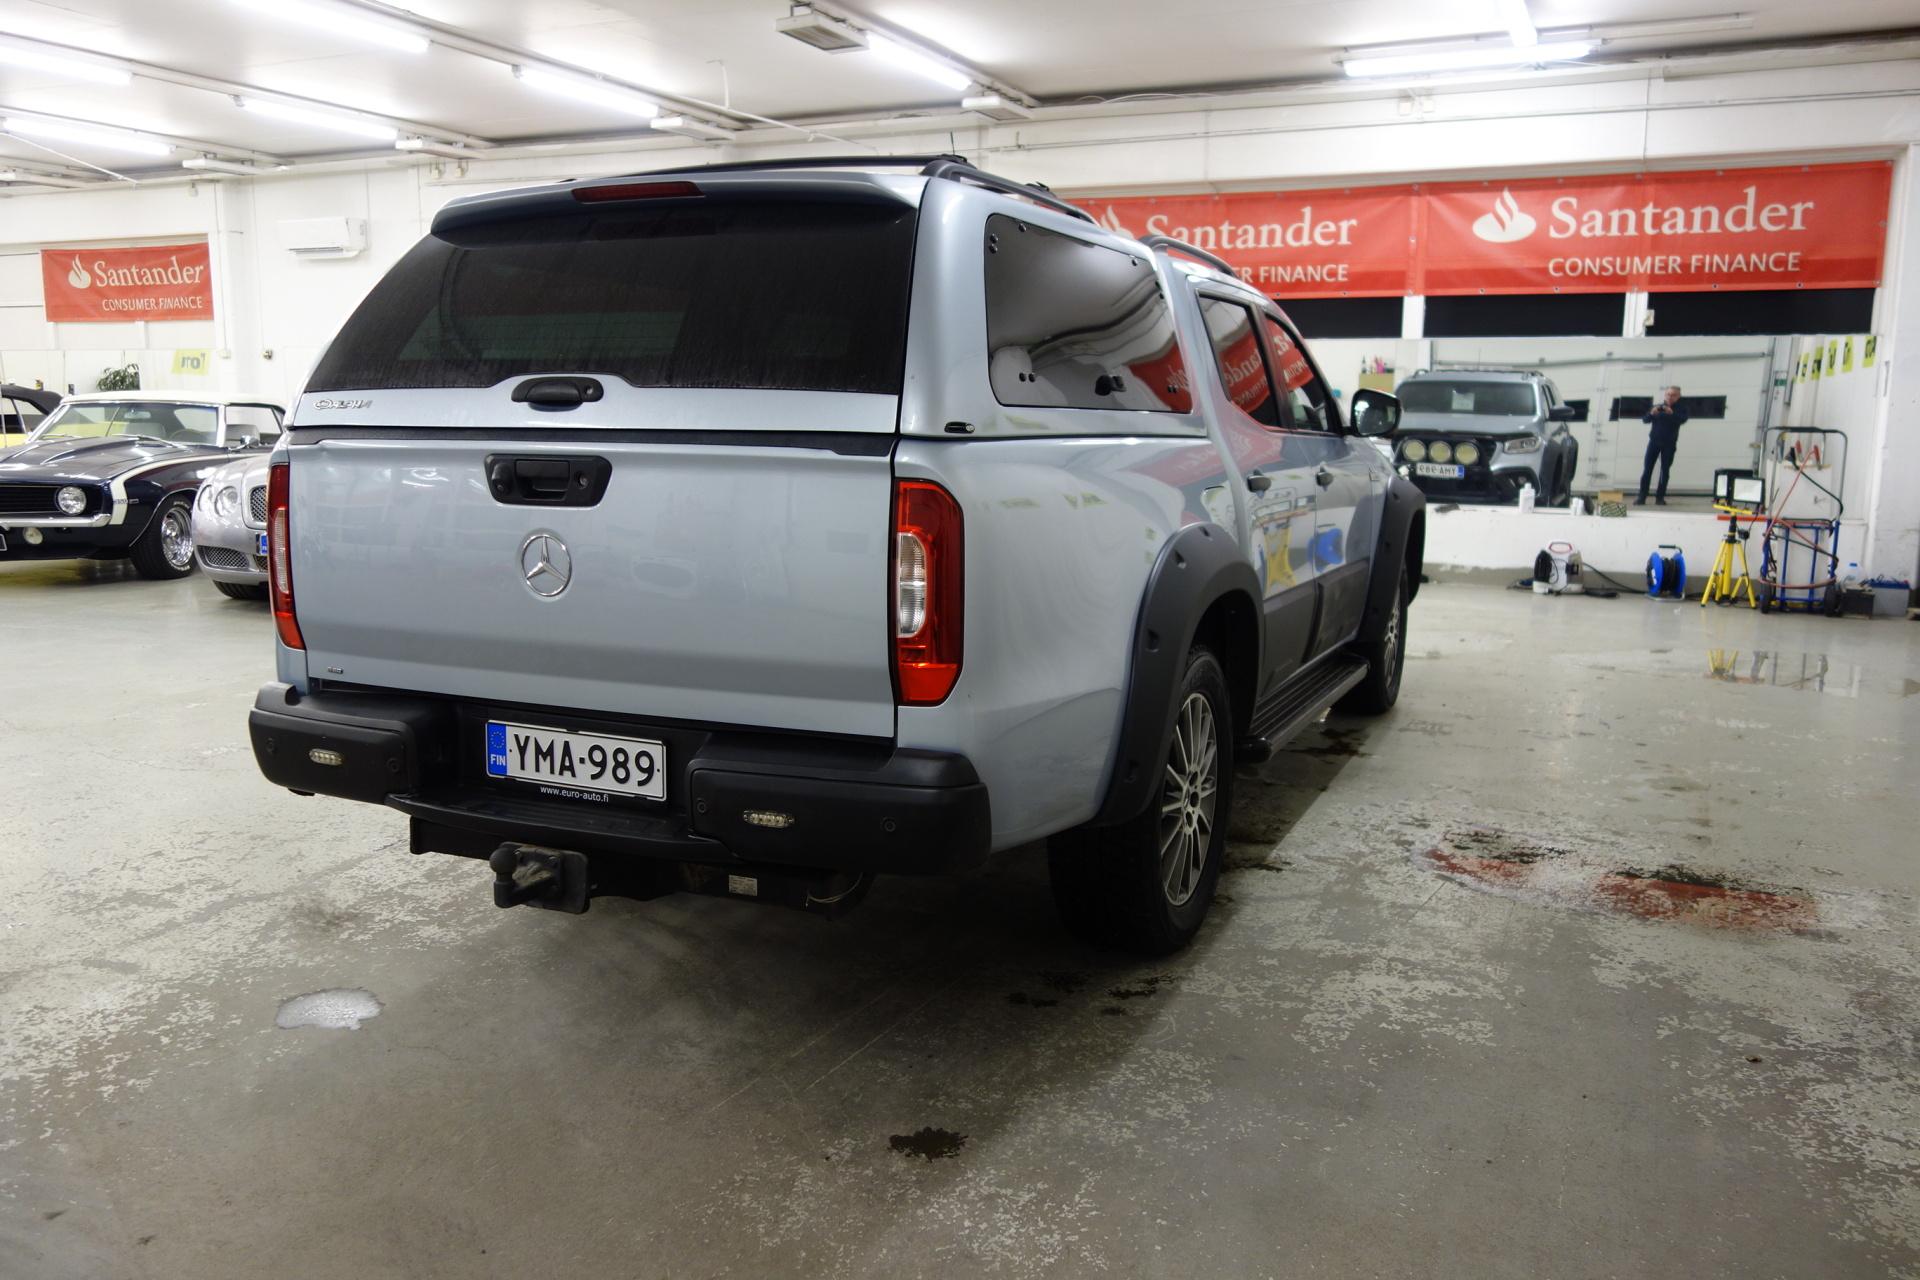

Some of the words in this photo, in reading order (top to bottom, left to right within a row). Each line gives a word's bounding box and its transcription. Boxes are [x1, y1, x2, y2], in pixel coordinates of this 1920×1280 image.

[1546, 186, 1815, 239] Santander
[93, 256, 205, 288] Santander
[1258, 263, 1349, 284] FINANCE
[1548, 255, 1682, 277] CONSUMER
[1690, 251, 1802, 274] FINANCE
[102, 297, 157, 312] CONSUMER
[158, 296, 203, 310] FINANCE
[490, 753, 506, 766] FIN
[513, 733, 655, 787] YMA-989
[540, 785, 609, 803] www.euro-auto.fi
